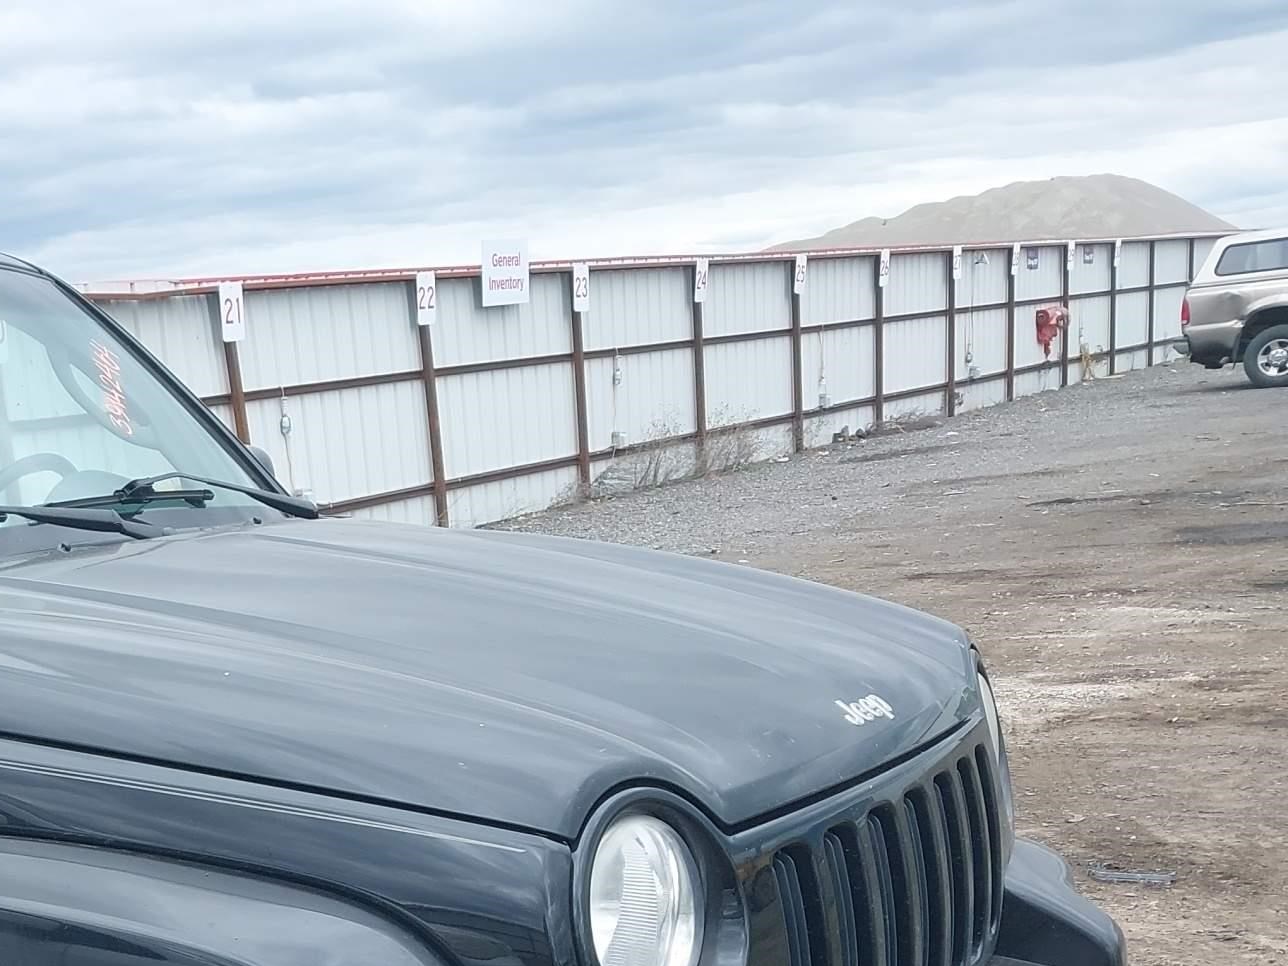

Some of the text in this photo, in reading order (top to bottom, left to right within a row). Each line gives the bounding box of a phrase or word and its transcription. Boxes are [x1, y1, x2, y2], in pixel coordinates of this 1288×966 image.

[491, 252, 521, 268] General
[879, 260, 889, 276] 26
[697, 270, 707, 289] 24
[795, 264, 806, 283] 25
[488, 275, 525, 292] Inventory
[575, 277, 588, 298] 23
[418, 286, 435, 310] 22
[224, 298, 241, 324] 21
[834, 693, 895, 726] Jeep
